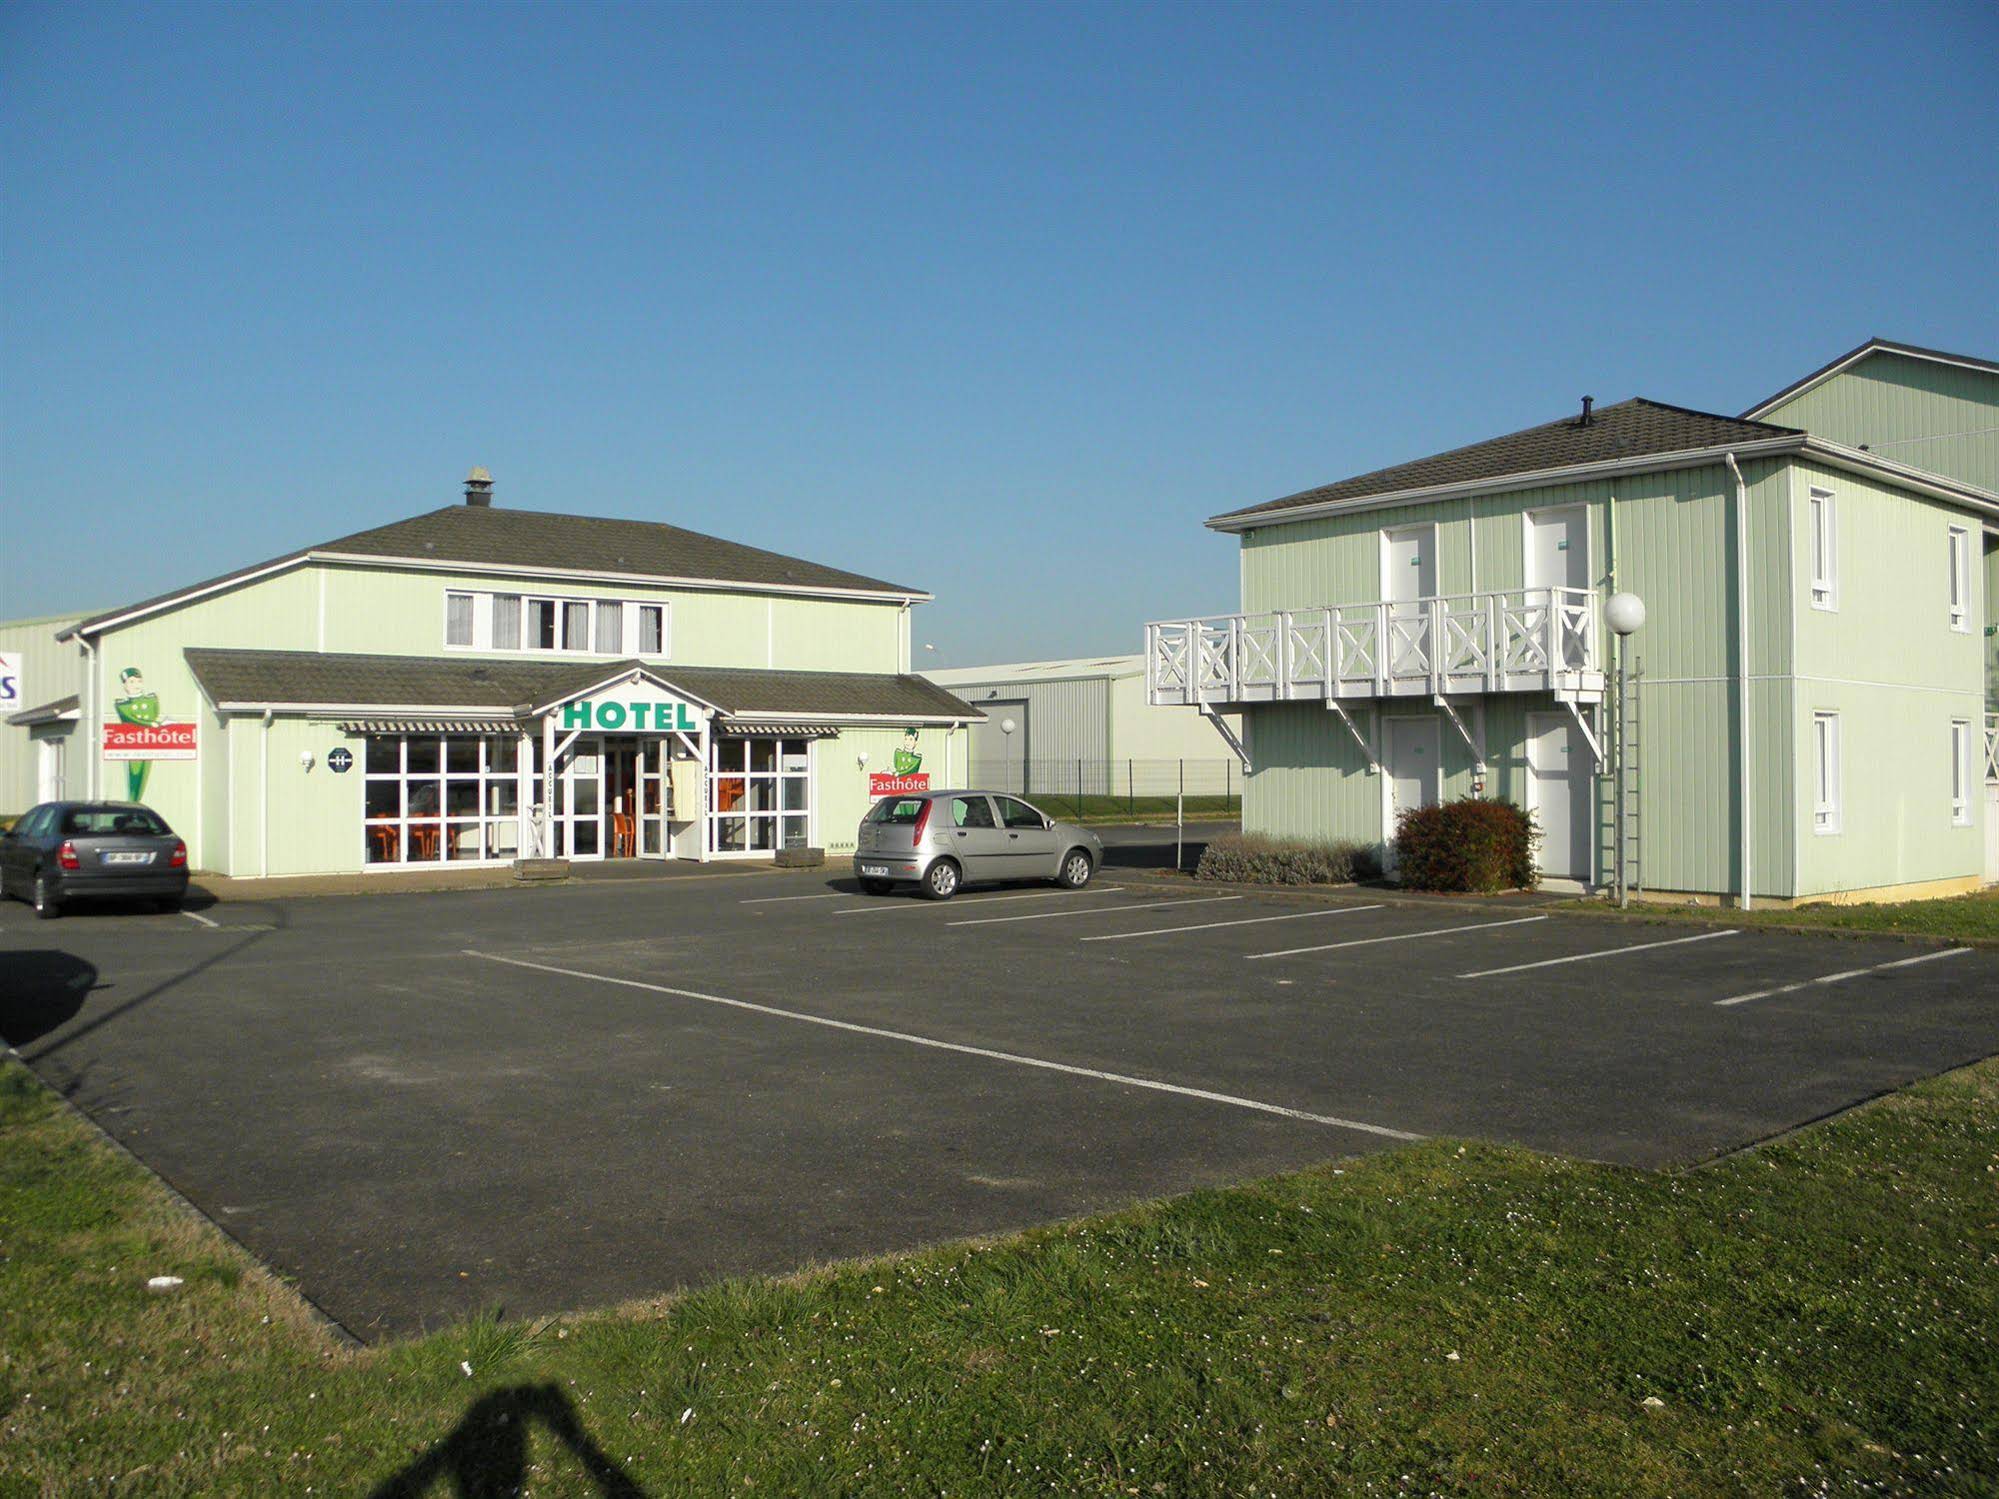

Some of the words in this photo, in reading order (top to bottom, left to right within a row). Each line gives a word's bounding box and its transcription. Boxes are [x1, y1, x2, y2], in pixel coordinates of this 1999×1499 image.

[563, 701, 696, 730] HOTEL
[103, 728, 197, 744] Fasthôtel
[335, 755, 345, 766] H
[869, 778, 930, 791] Fasthôtel
